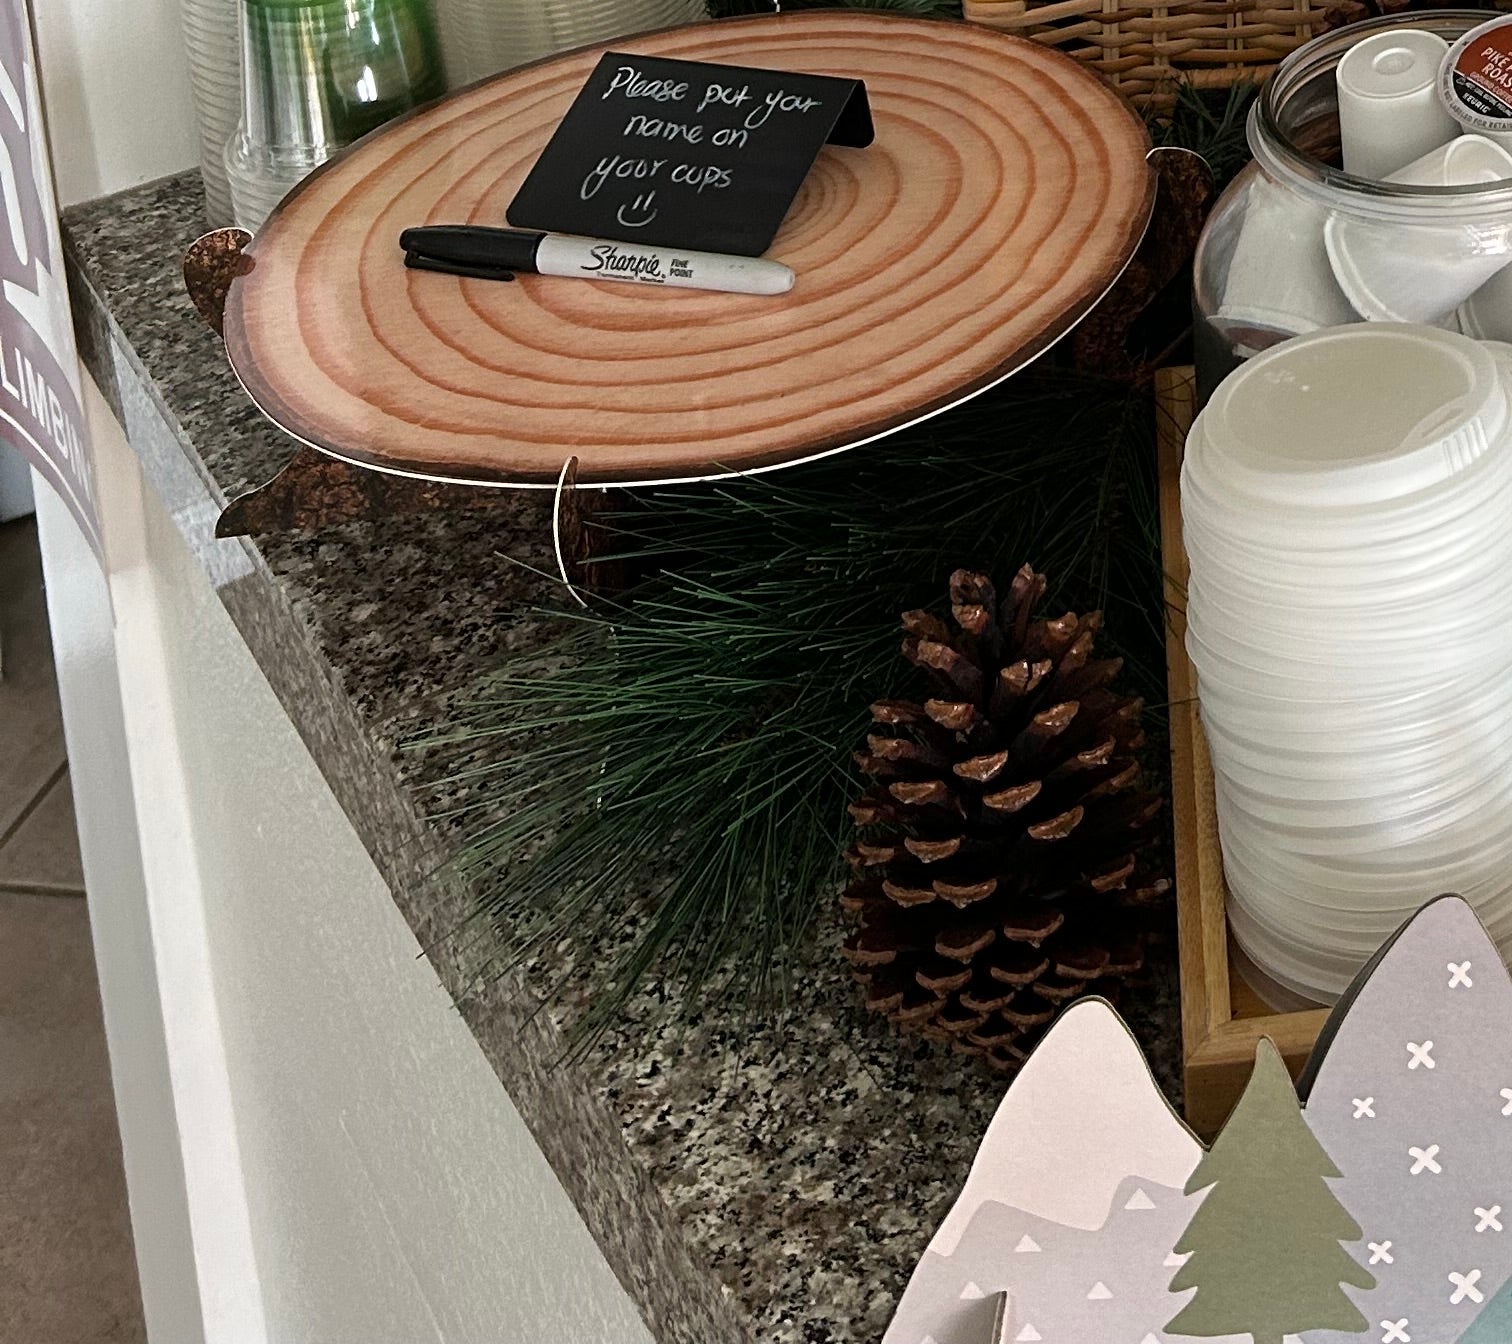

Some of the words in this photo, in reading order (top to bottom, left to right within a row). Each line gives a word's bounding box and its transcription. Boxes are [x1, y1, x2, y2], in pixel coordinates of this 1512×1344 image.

[1481, 47, 1511, 68] PIKE
[602, 66, 689, 102] Please
[696, 83, 752, 113] put
[623, 115, 704, 145] name
[711, 128, 748, 149] on
[579, 155, 669, 201] your
[671, 164, 734, 194] cups
[580, 244, 662, 278] Sharpie
[669, 267, 694, 279] POINT
[671, 258, 689, 269] FINE
[0, 335, 91, 502] LIMBIN
